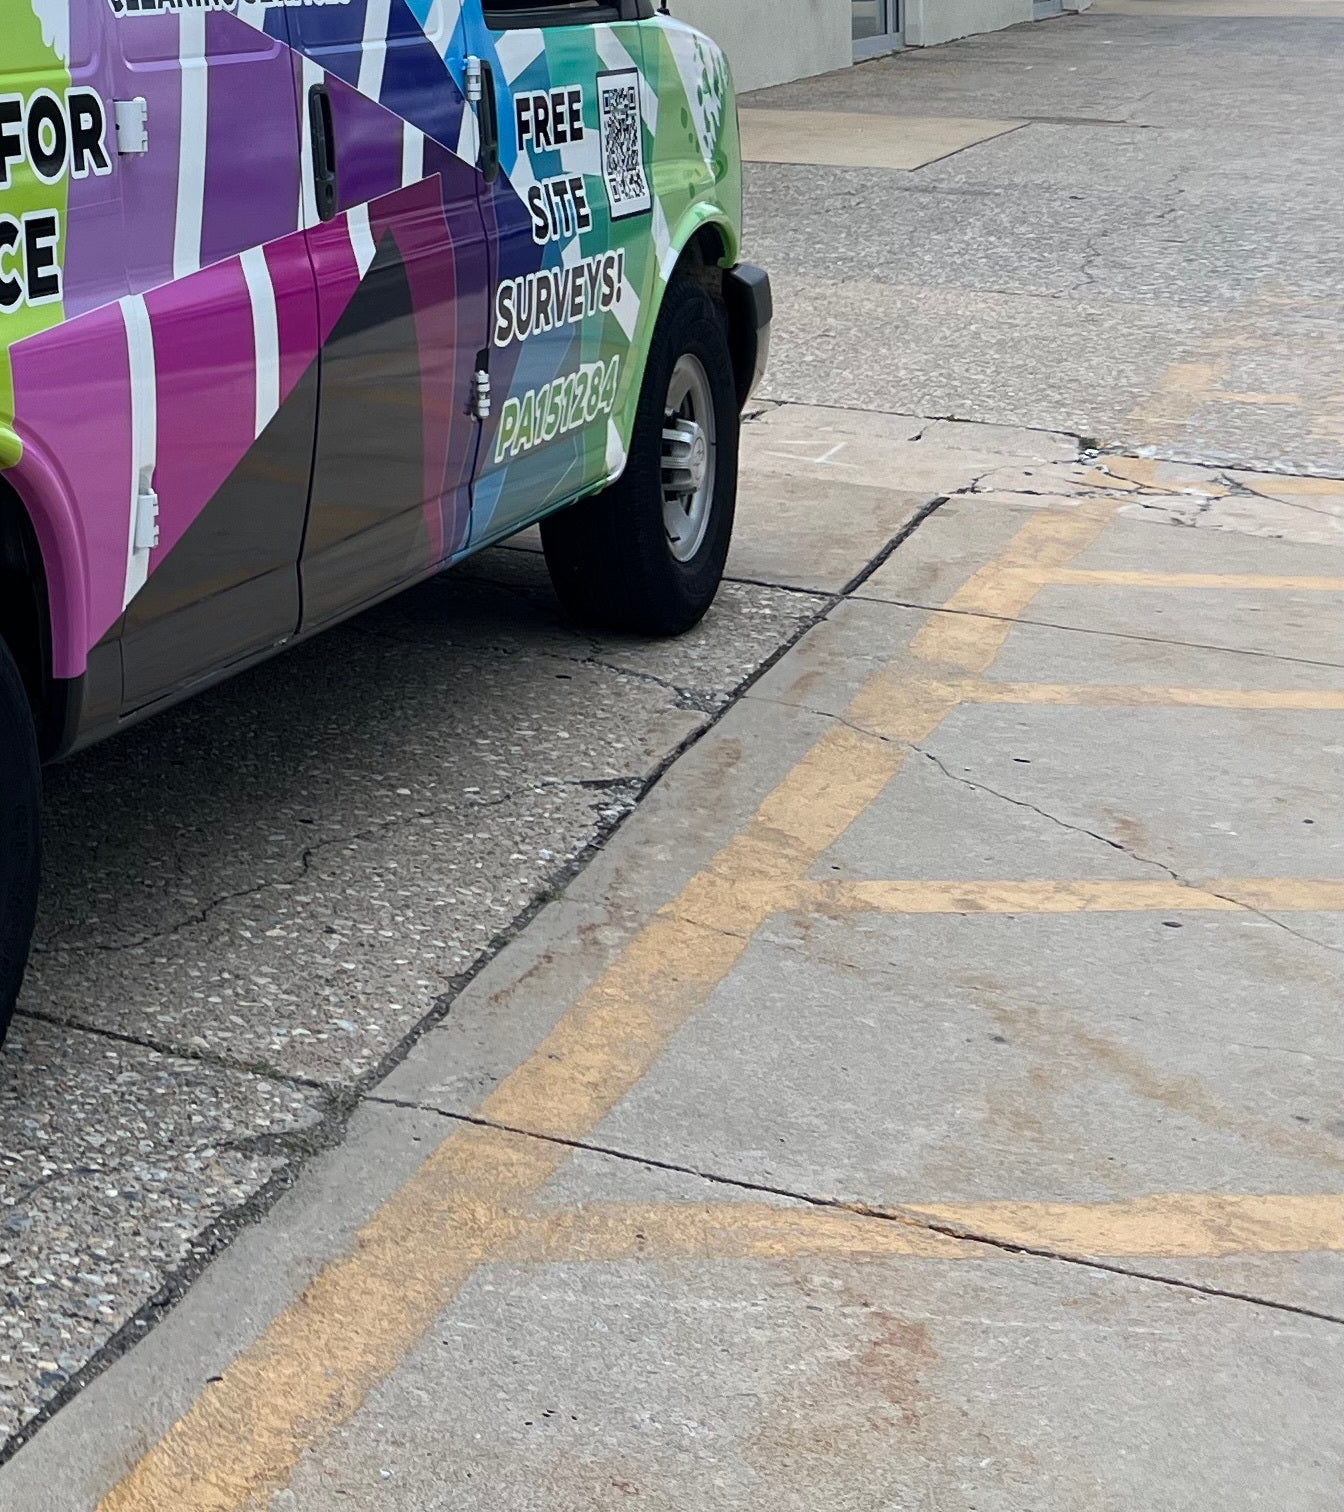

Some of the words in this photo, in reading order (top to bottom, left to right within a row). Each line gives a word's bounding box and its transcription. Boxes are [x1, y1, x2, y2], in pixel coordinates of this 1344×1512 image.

[513, 87, 585, 154] FREE
[527, 175, 591, 243] SITE
[494, 249, 627, 348] SURVEYS!
[493, 354, 620, 463] PA151284
